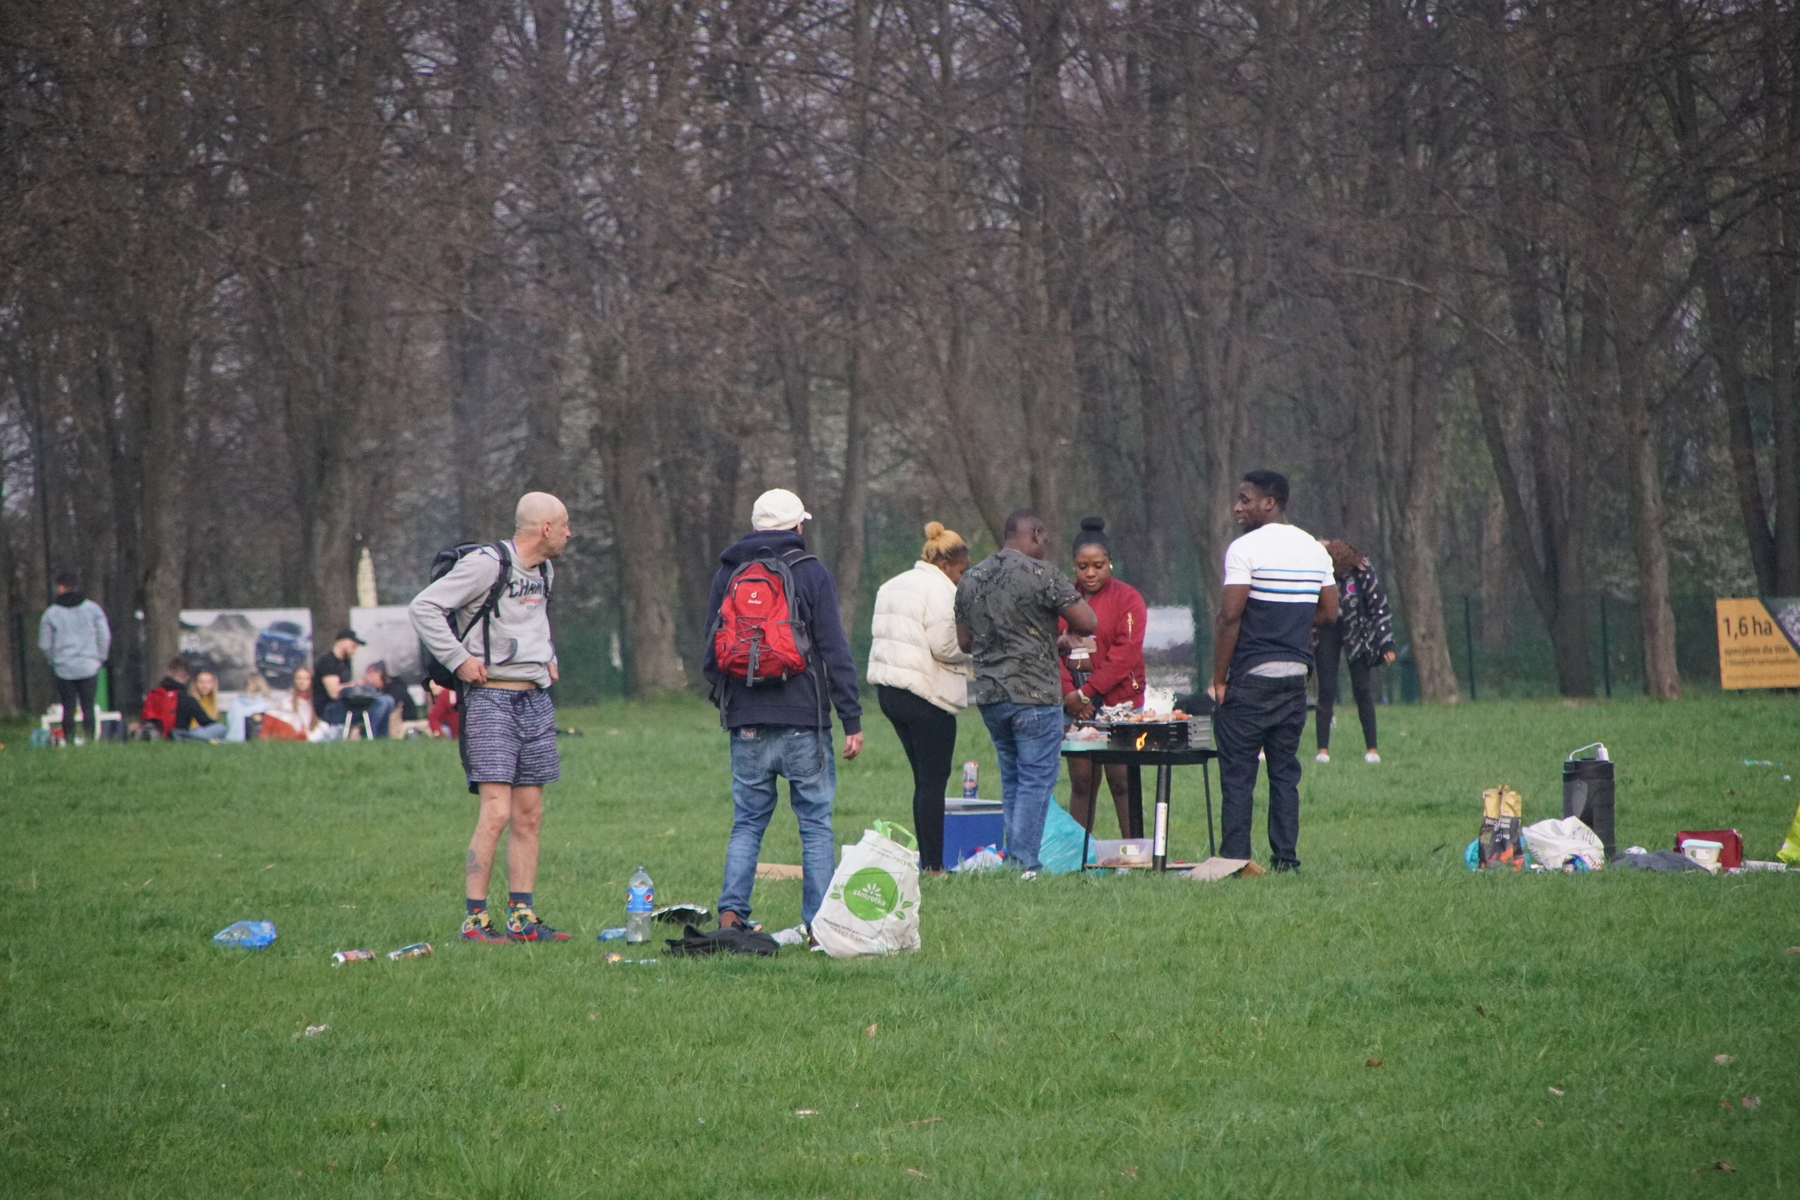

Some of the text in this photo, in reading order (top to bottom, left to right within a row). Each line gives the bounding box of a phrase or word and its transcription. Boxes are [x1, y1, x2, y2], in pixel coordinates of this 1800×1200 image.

[1724, 616, 1773, 640] 1,6 ha
[852, 889, 886, 907] stokrotka
